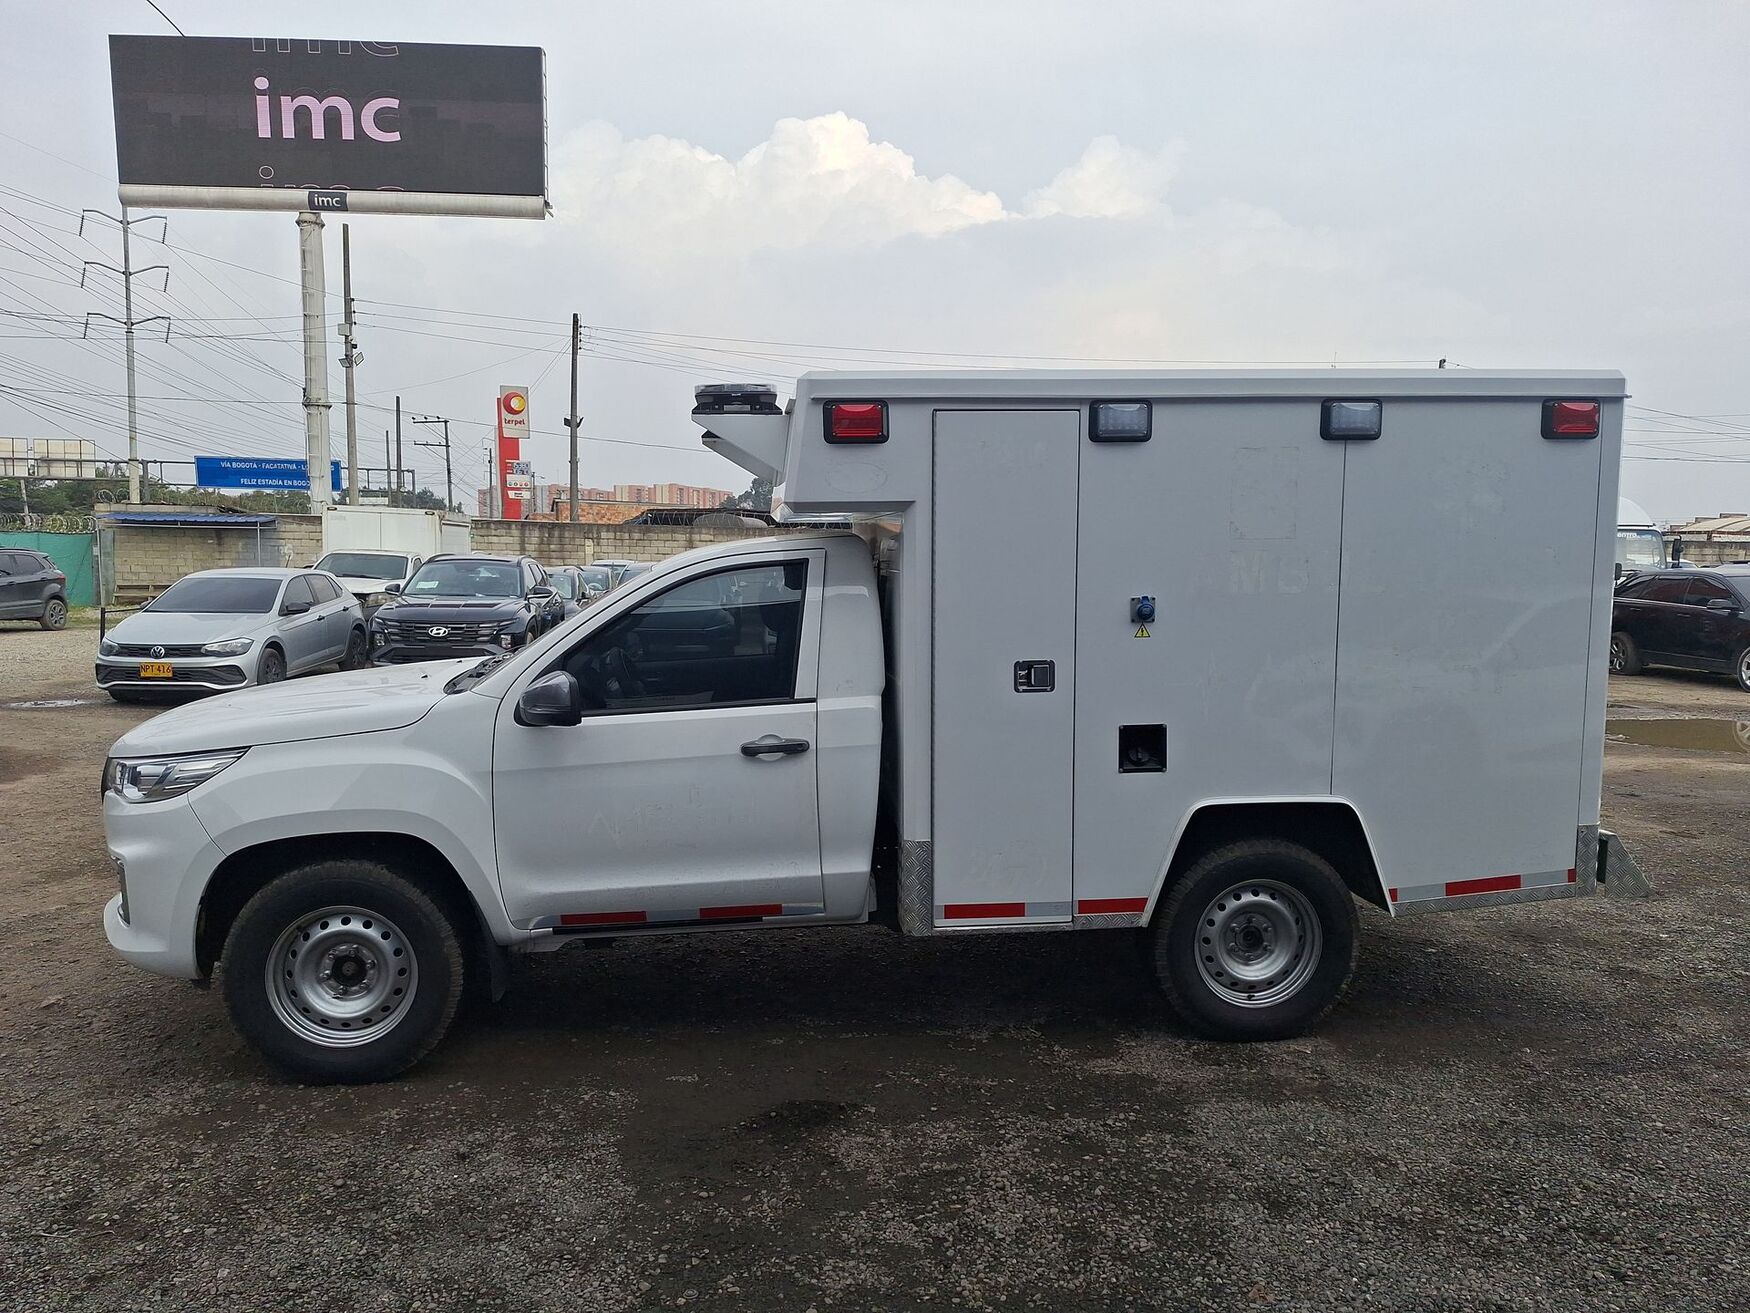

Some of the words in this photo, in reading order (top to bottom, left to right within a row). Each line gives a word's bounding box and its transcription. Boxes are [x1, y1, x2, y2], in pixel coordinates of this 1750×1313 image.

[254, 76, 401, 142] imc
[314, 194, 341, 207] imc
[504, 418, 526, 426] terpel
[140, 664, 154, 673] NPT
[156, 665, 171, 674] 416
